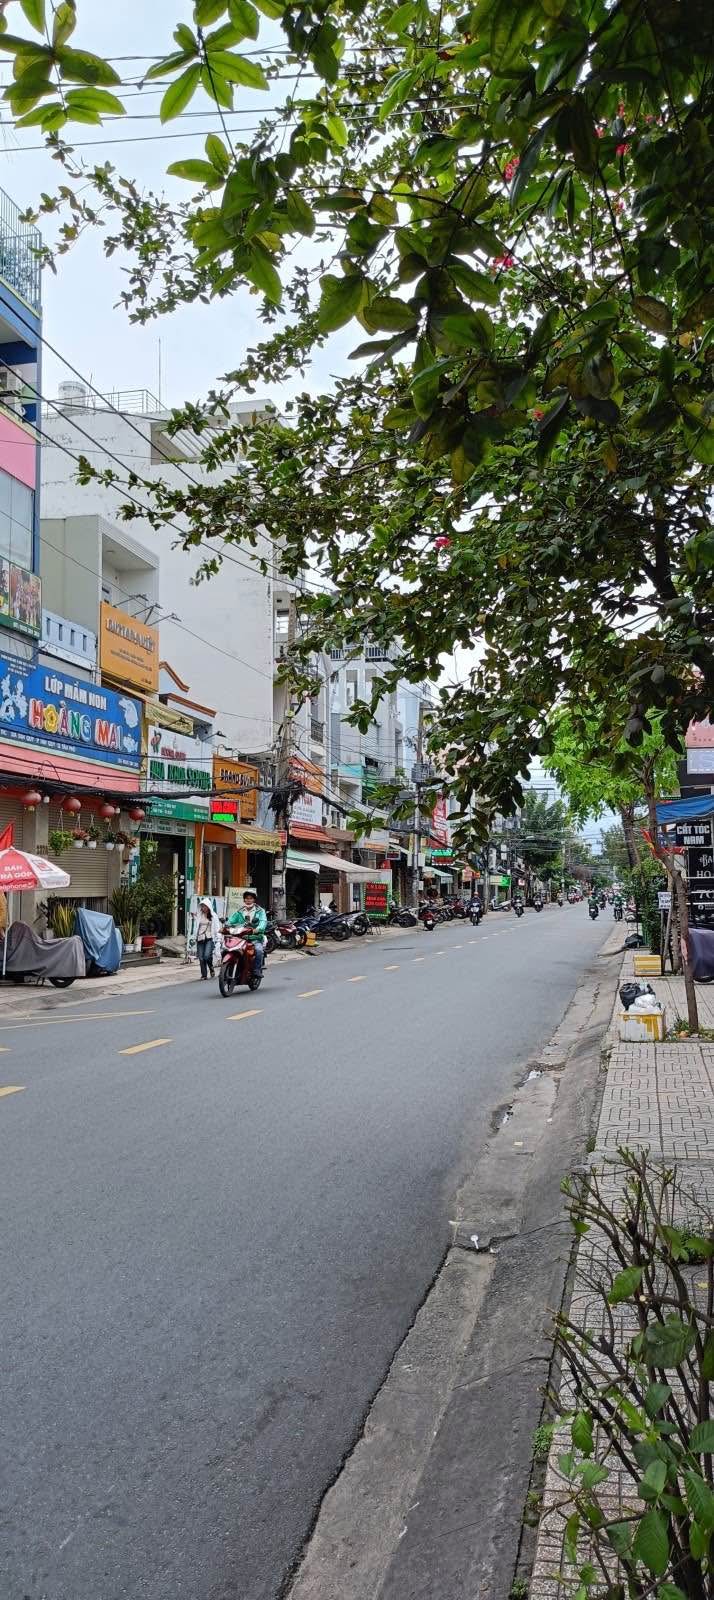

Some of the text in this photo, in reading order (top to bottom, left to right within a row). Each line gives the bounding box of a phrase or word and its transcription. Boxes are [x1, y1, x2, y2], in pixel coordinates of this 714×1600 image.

[88, 691, 107, 711] NON
[95, 718, 123, 752] MAI
[683, 835, 705, 845] NAM
